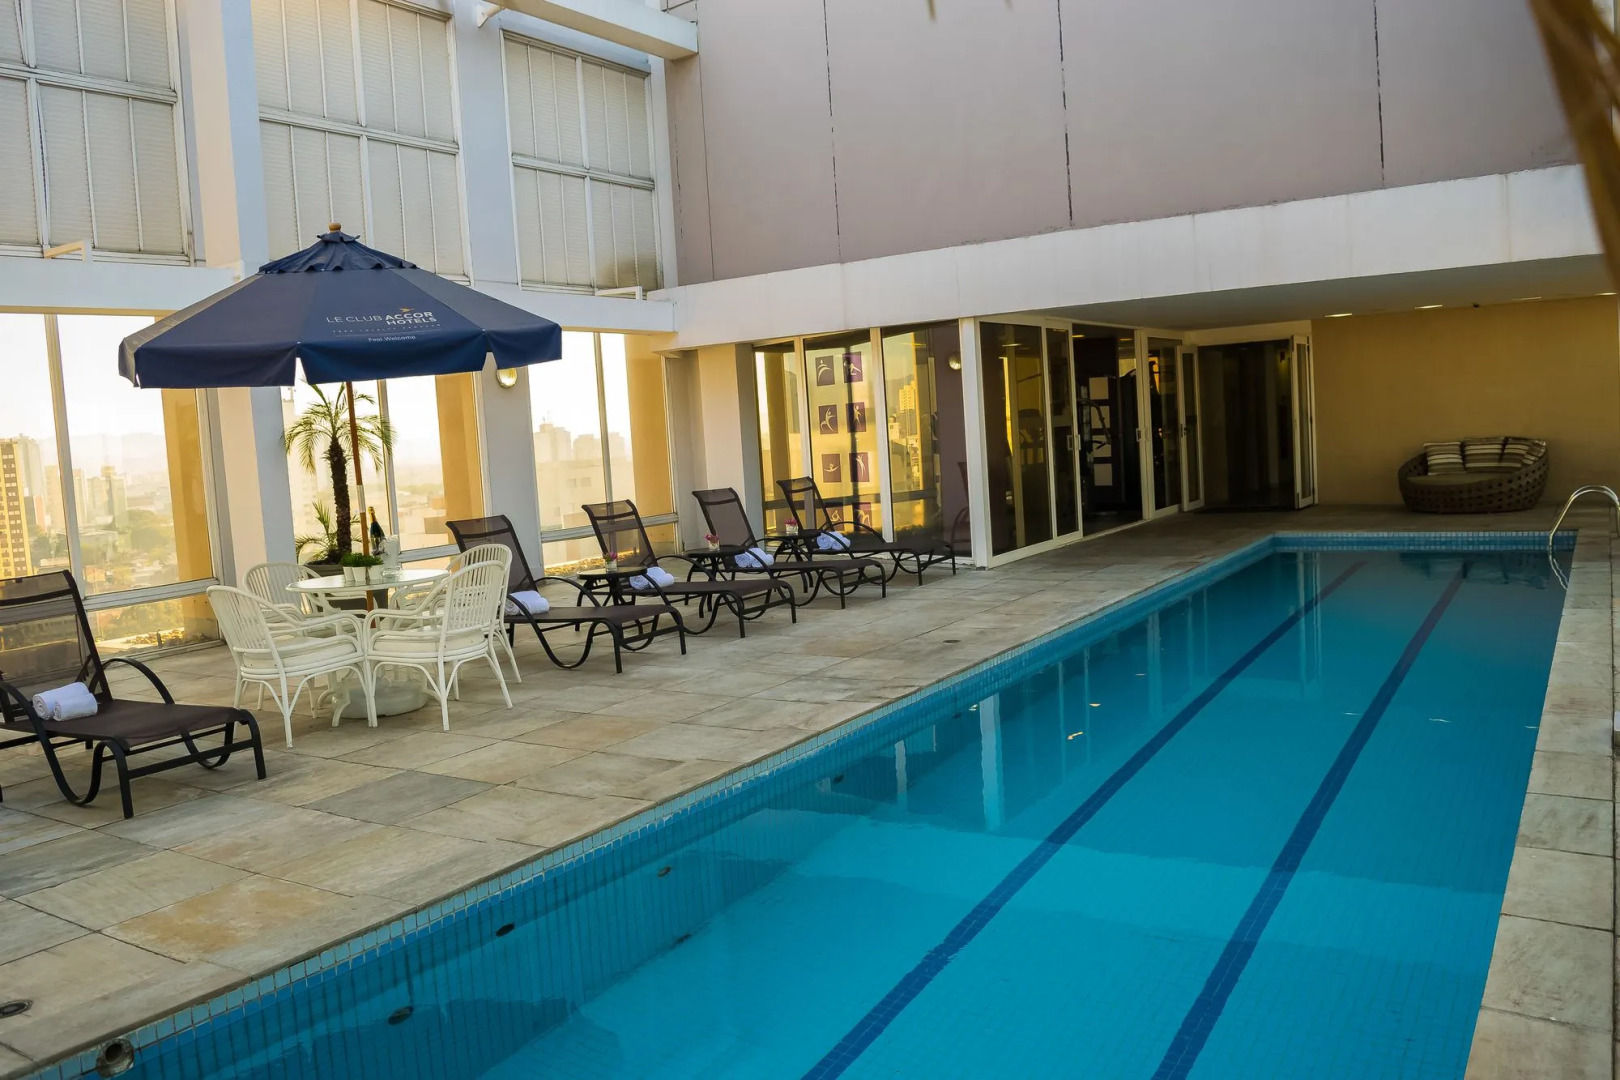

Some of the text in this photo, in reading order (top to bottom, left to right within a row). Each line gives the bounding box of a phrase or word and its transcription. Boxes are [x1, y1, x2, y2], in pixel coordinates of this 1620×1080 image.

[345, 315, 383, 323] CLUB
[385, 311, 433, 321] ACCOR
[386, 317, 437, 326] HOTELS
